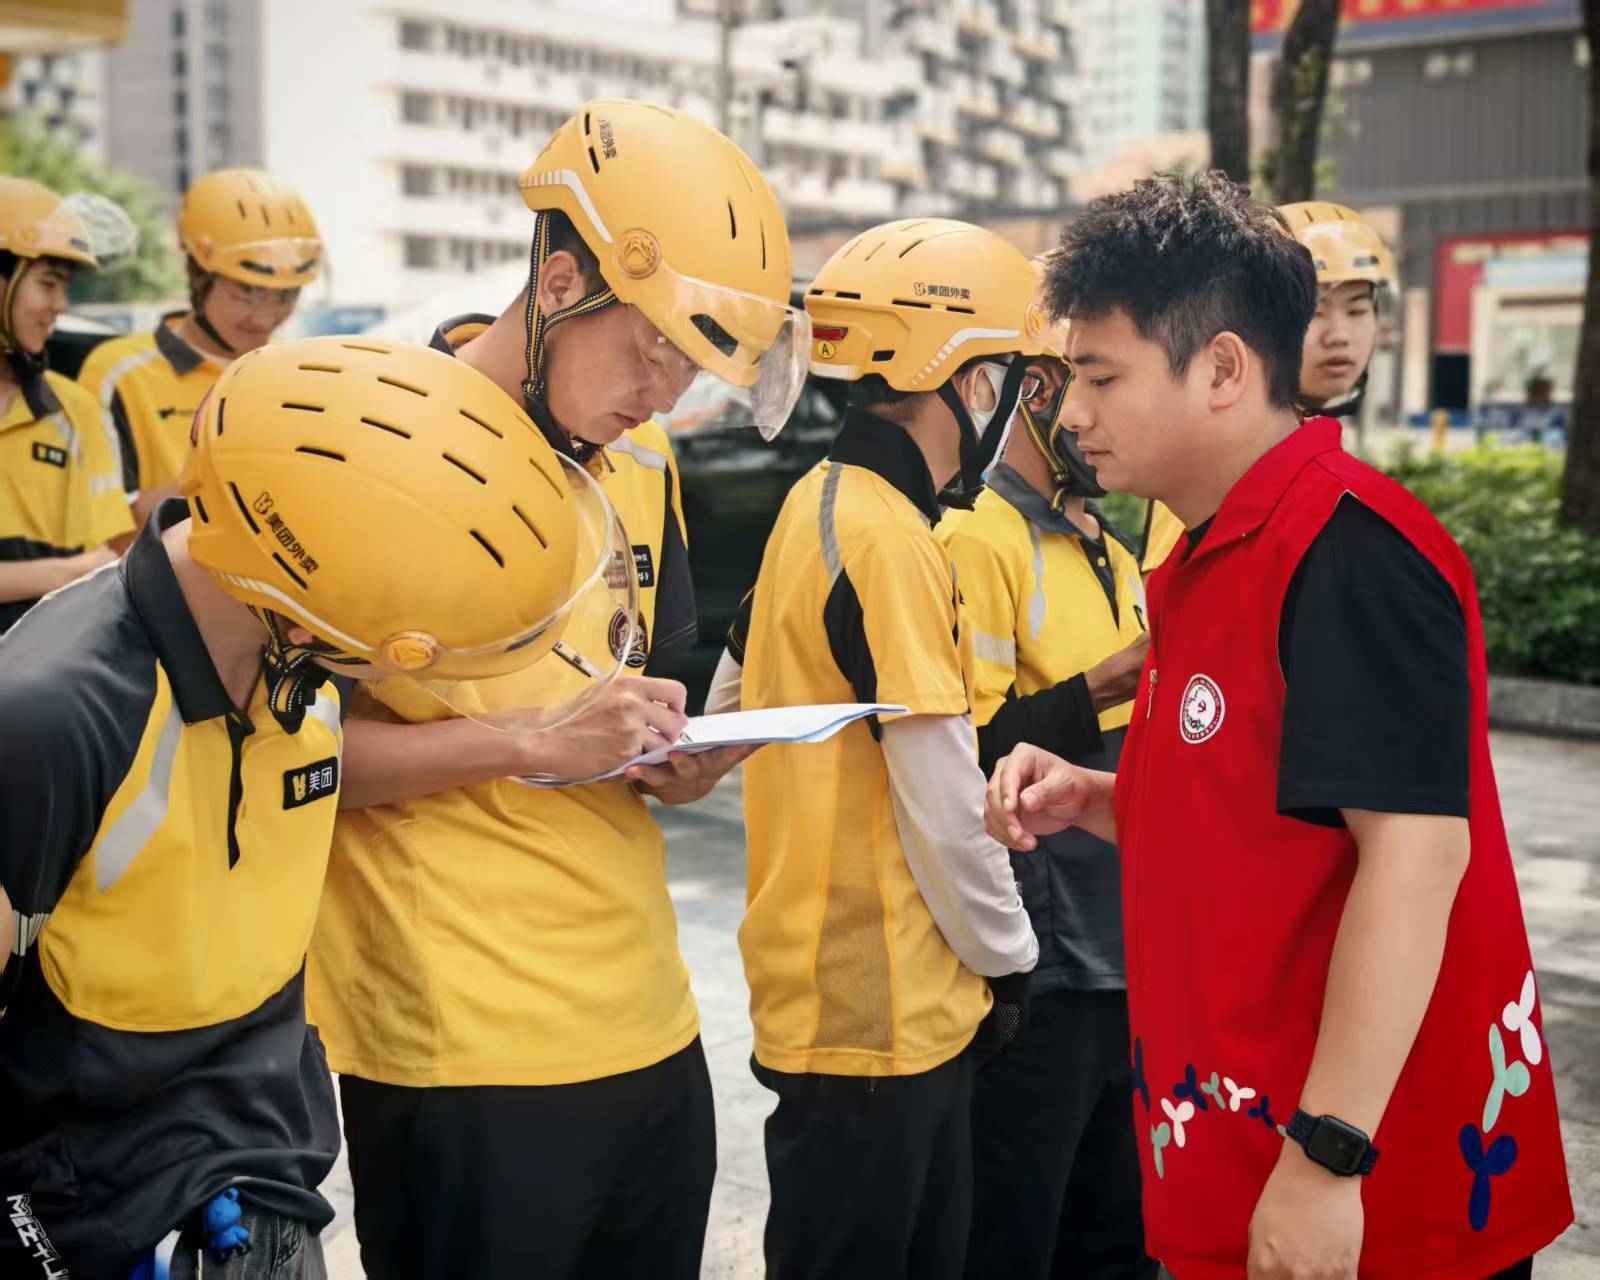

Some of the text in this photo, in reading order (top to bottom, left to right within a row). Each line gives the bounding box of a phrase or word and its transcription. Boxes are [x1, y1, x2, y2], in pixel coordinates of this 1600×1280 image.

[927, 284, 971, 300] 美团外卖
[822, 344, 830, 356] A
[265, 512, 319, 575] 美团外卖
[309, 766, 333, 794] 美团
